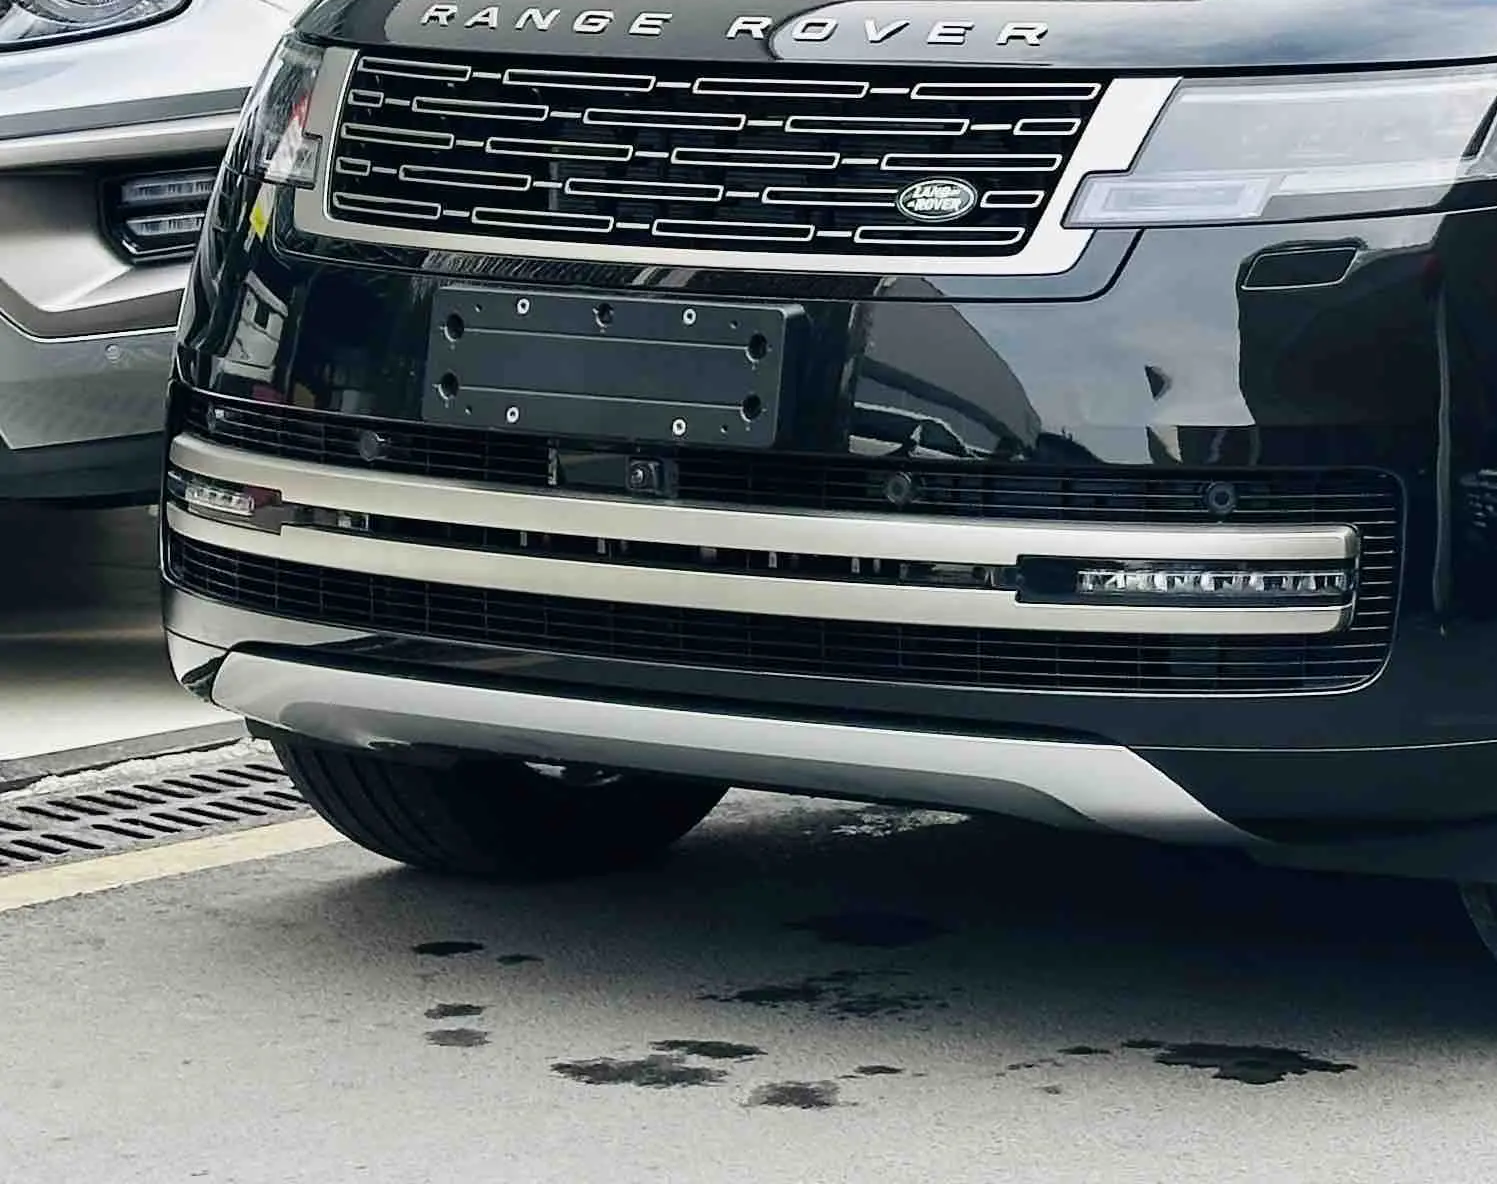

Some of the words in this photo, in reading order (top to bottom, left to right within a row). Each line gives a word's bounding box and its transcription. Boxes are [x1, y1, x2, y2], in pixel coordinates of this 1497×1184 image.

[420, 3, 673, 36] RANGE
[726, 15, 1049, 47] ROVER
[911, 185, 952, 199] LAND
[914, 198, 961, 211] ROVER
